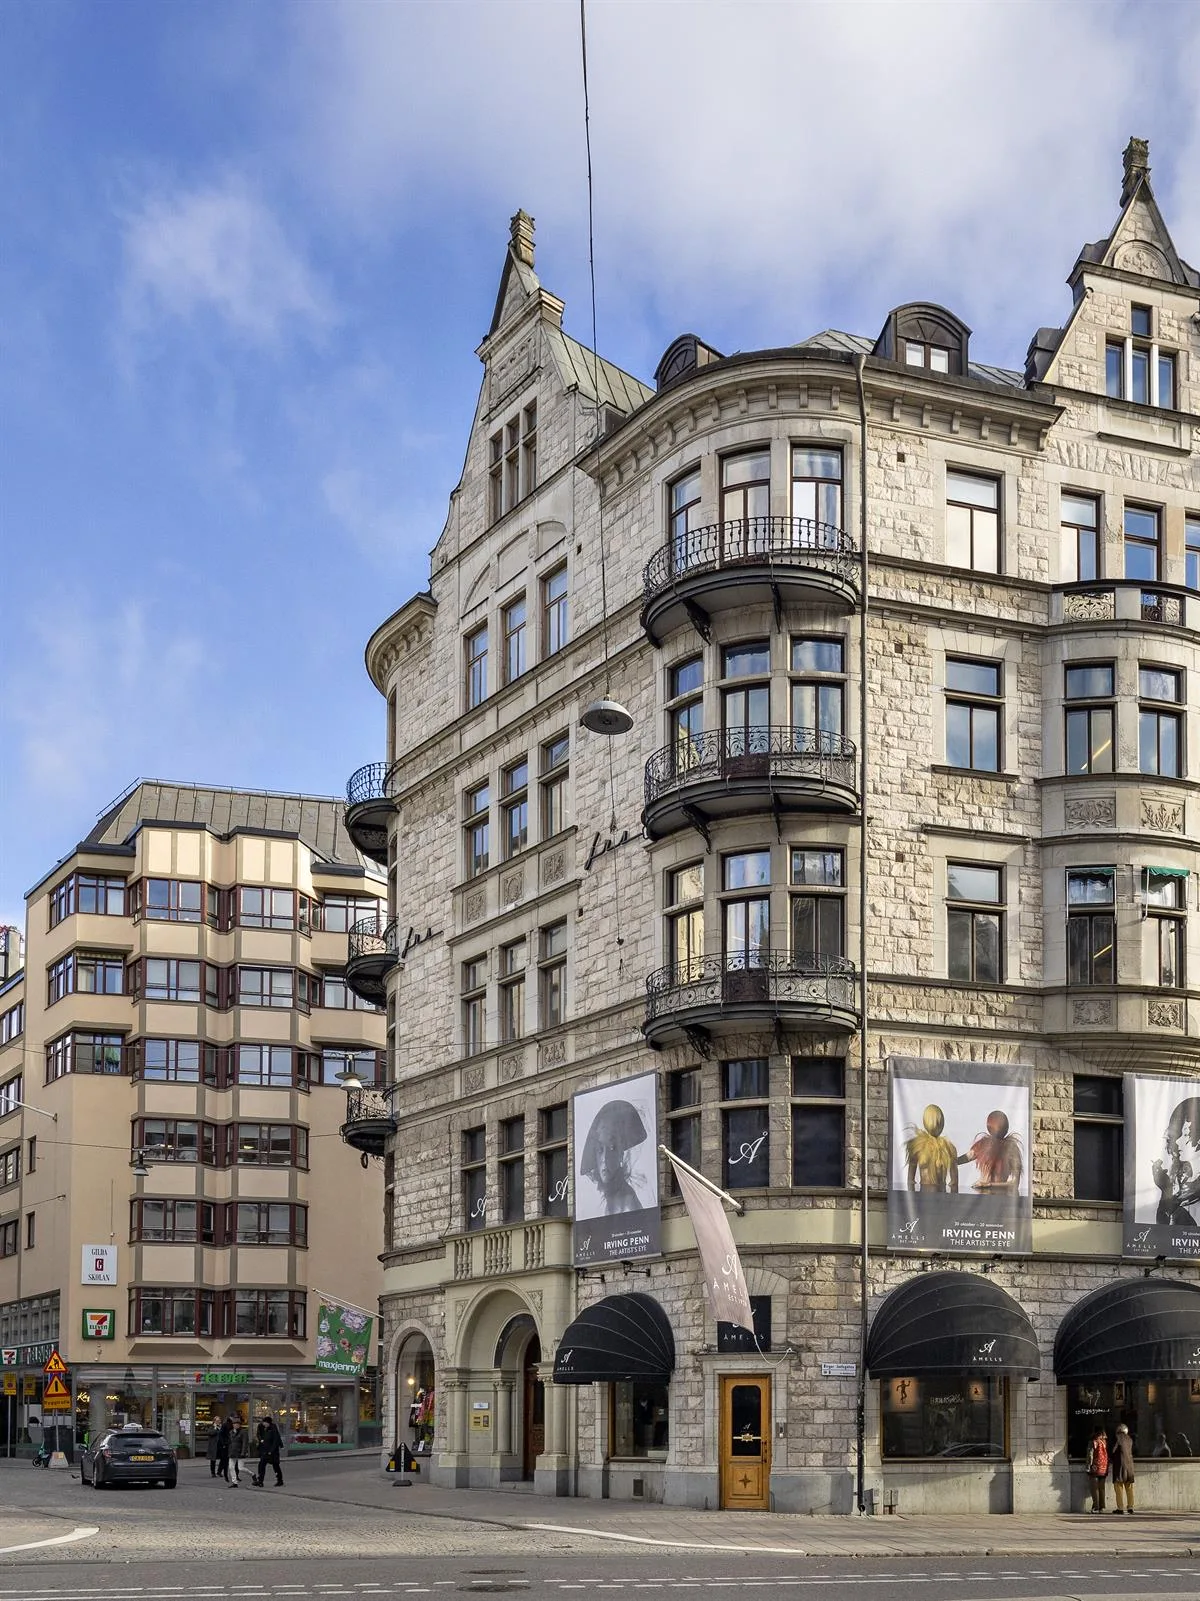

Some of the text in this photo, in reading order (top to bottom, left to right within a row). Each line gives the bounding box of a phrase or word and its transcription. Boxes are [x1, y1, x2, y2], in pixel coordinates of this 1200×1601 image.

[942, 1228, 1015, 1240] IRVING PENN
[604, 1235, 650, 1250] IRVING PENN
[966, 1239, 996, 1247] ARTIST'S
[91, 1248, 108, 1256] GILDA
[318, 1360, 361, 1374] maxjenny!
